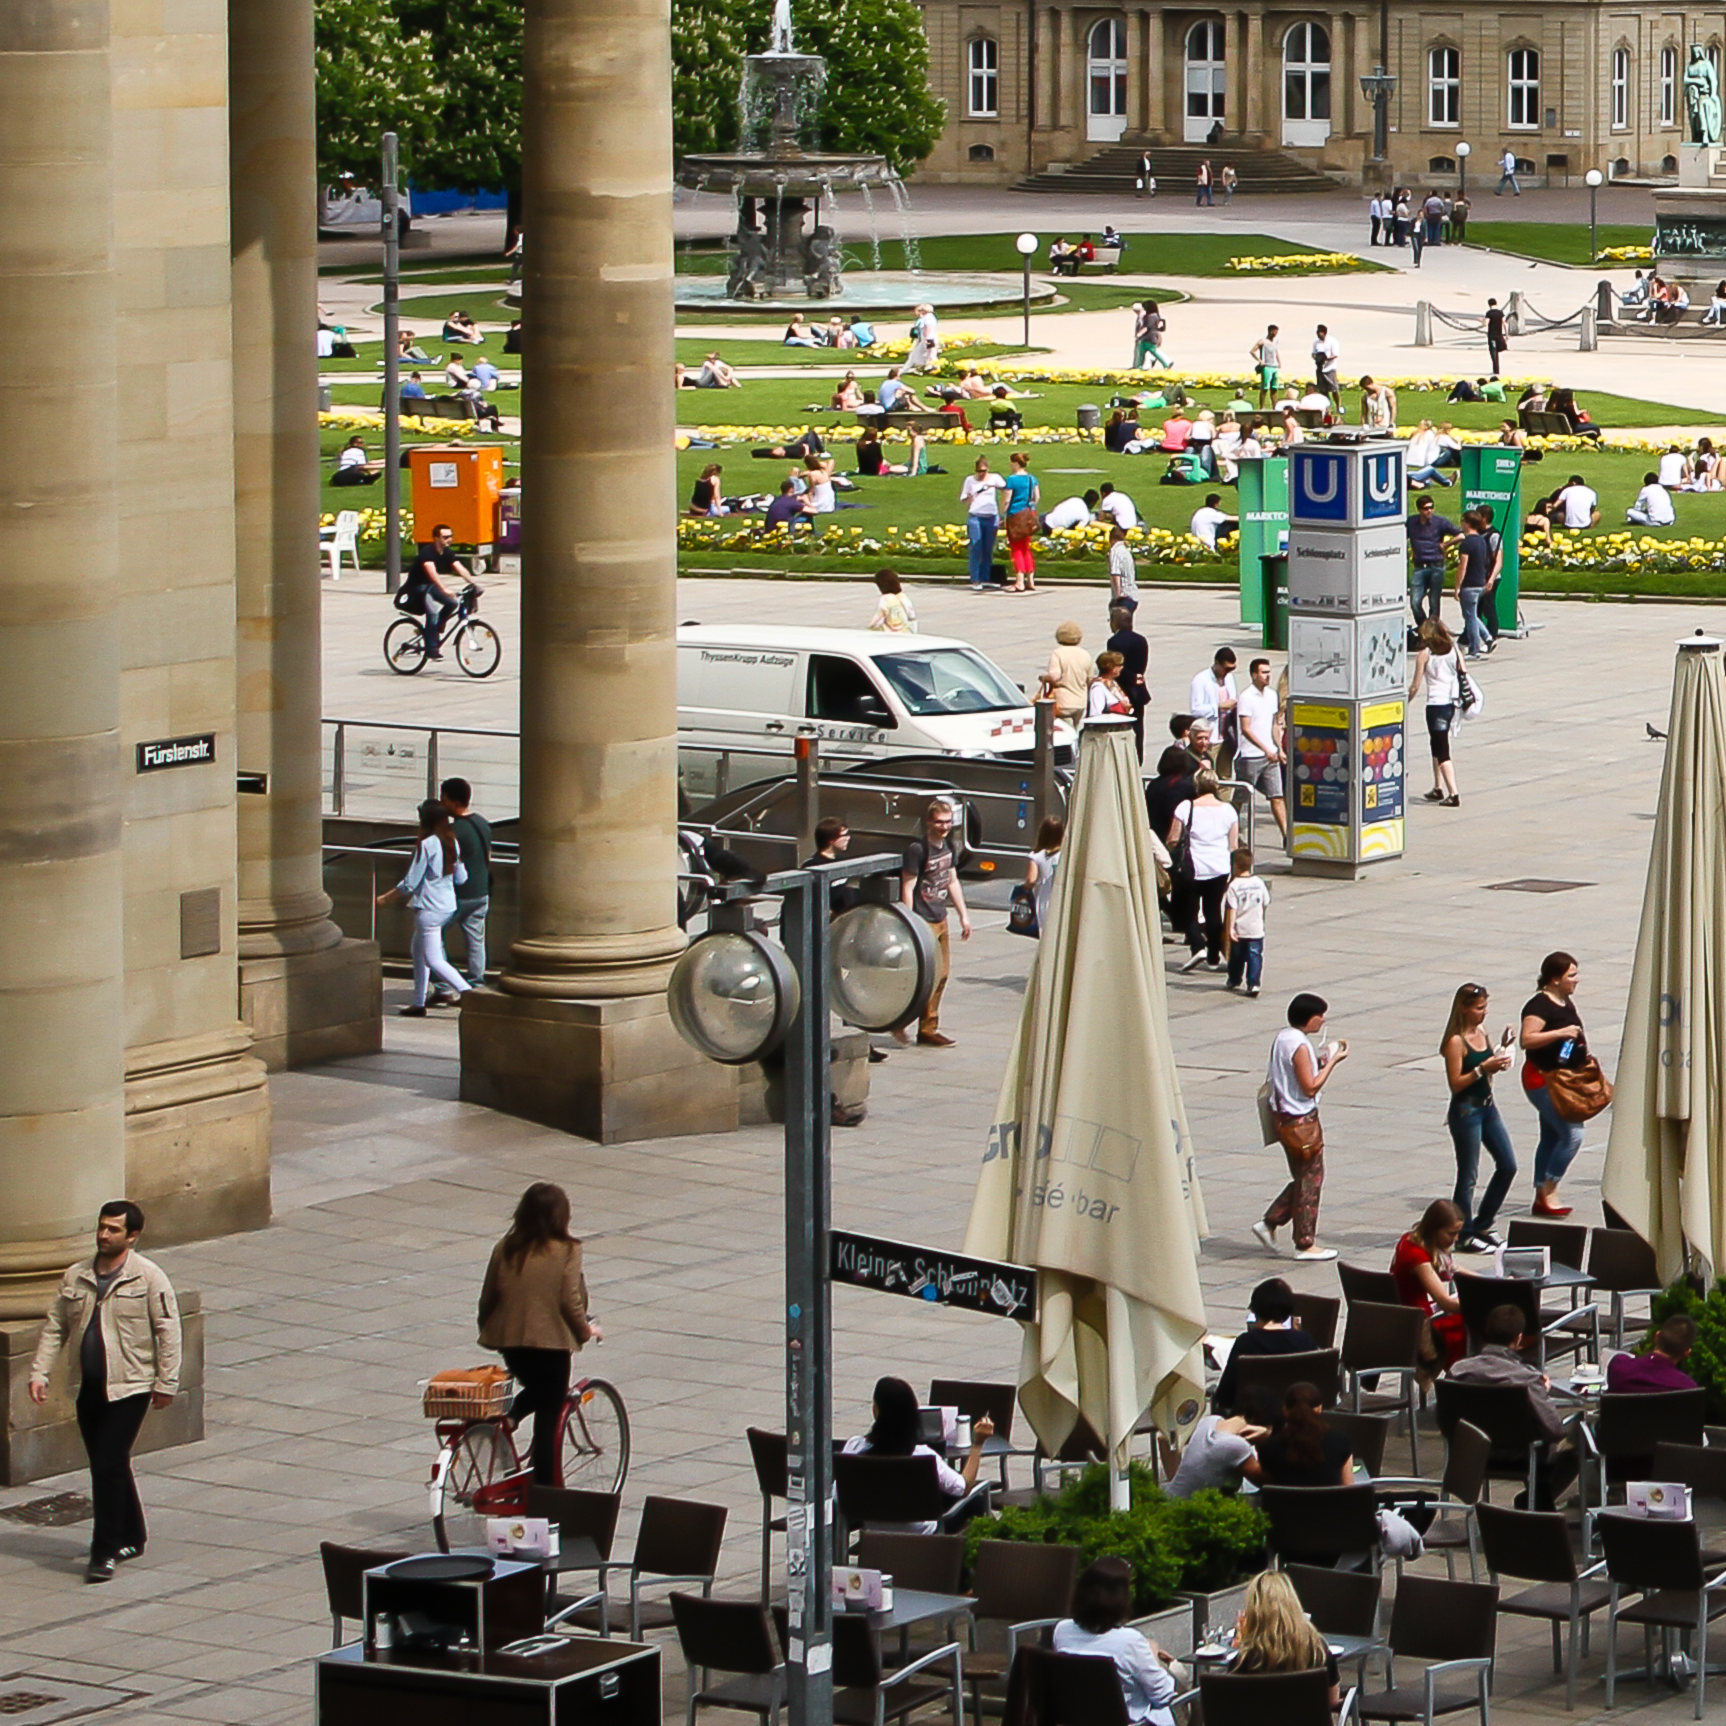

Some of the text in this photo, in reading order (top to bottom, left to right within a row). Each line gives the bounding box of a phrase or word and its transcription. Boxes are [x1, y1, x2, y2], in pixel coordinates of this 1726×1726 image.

[1304, 458, 1338, 503] U
[1368, 456, 1396, 502] U
[818, 724, 886, 743] Service
[144, 739, 210, 766] Fürstenstr.
